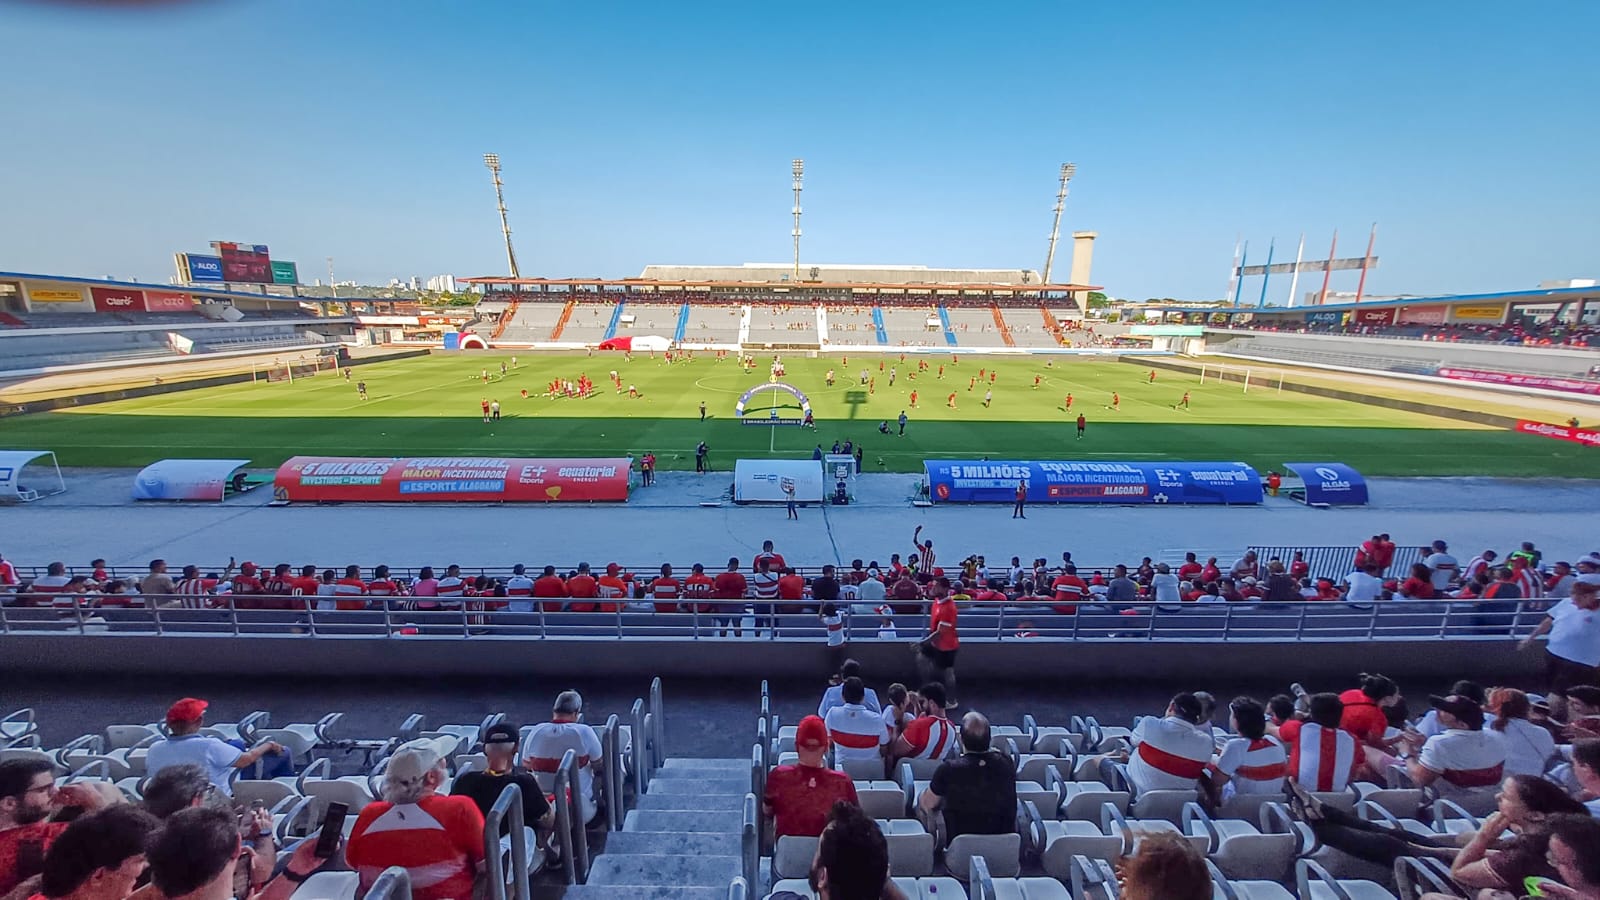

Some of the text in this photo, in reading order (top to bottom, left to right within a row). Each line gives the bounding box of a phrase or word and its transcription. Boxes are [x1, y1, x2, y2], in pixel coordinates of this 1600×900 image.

[106, 295, 133, 305] Claro
[301, 463, 320, 475] 5
[314, 461, 393, 475] MILHÕES
[558, 466, 616, 478] equatorial
[951, 465, 961, 478] 5
[963, 464, 1031, 478] MILHÕES
[402, 469, 508, 479] MAIOR INCENTIVADORA
[1046, 474, 1146, 483] MAIOR INCENTIVADORA
[1191, 470, 1248, 481] equatorial
[459, 481, 501, 491] ALAGOANO
[1104, 486, 1144, 495] ALAGOANO
